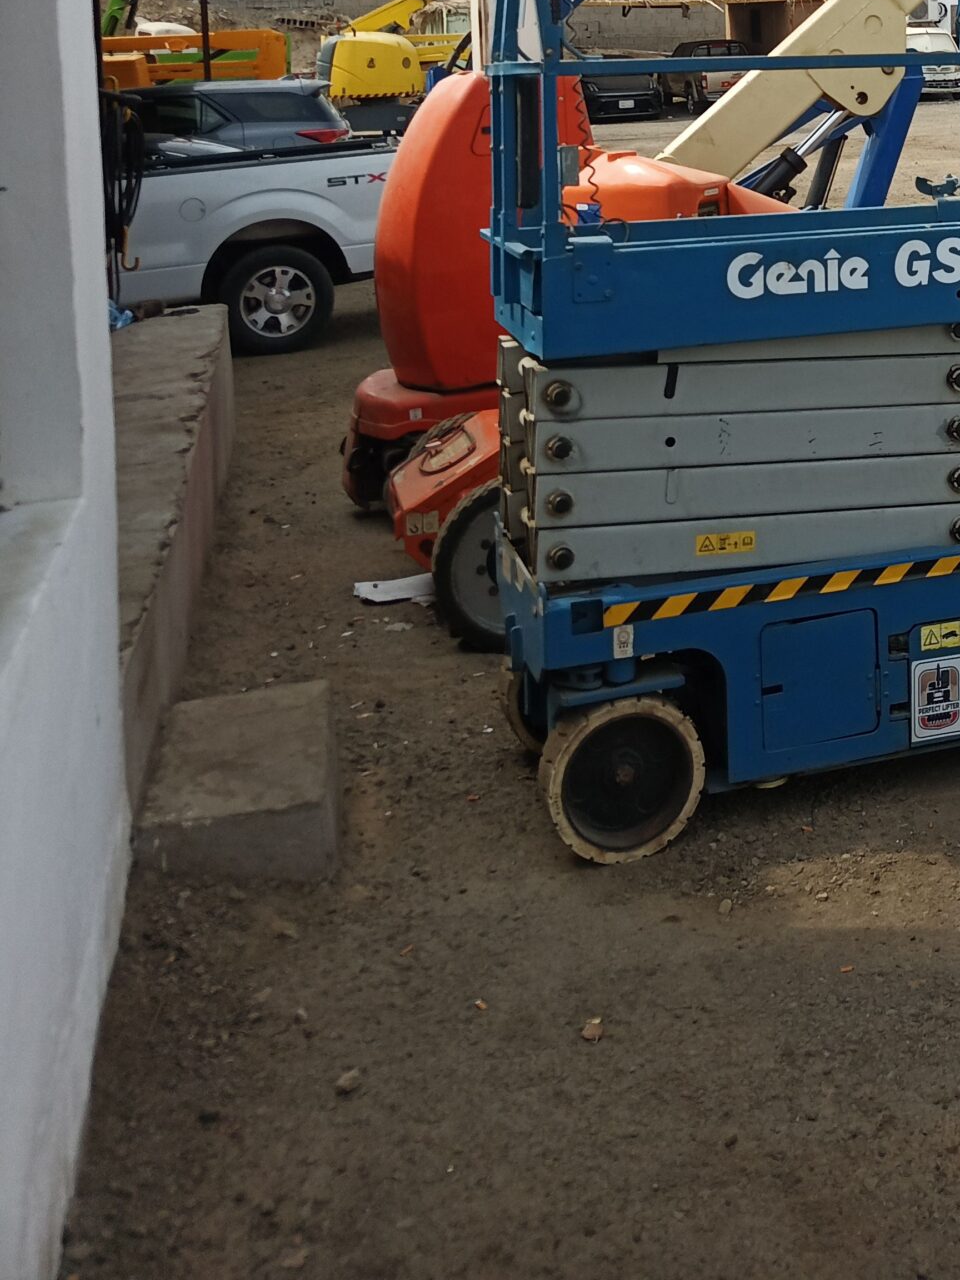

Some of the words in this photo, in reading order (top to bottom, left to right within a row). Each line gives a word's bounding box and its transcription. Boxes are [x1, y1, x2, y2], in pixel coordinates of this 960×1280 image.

[327, 171, 388, 188] STX
[726, 248, 870, 299] Genie
[918, 705, 942, 715] PERFECT
[941, 702, 960, 712] LIFTER
